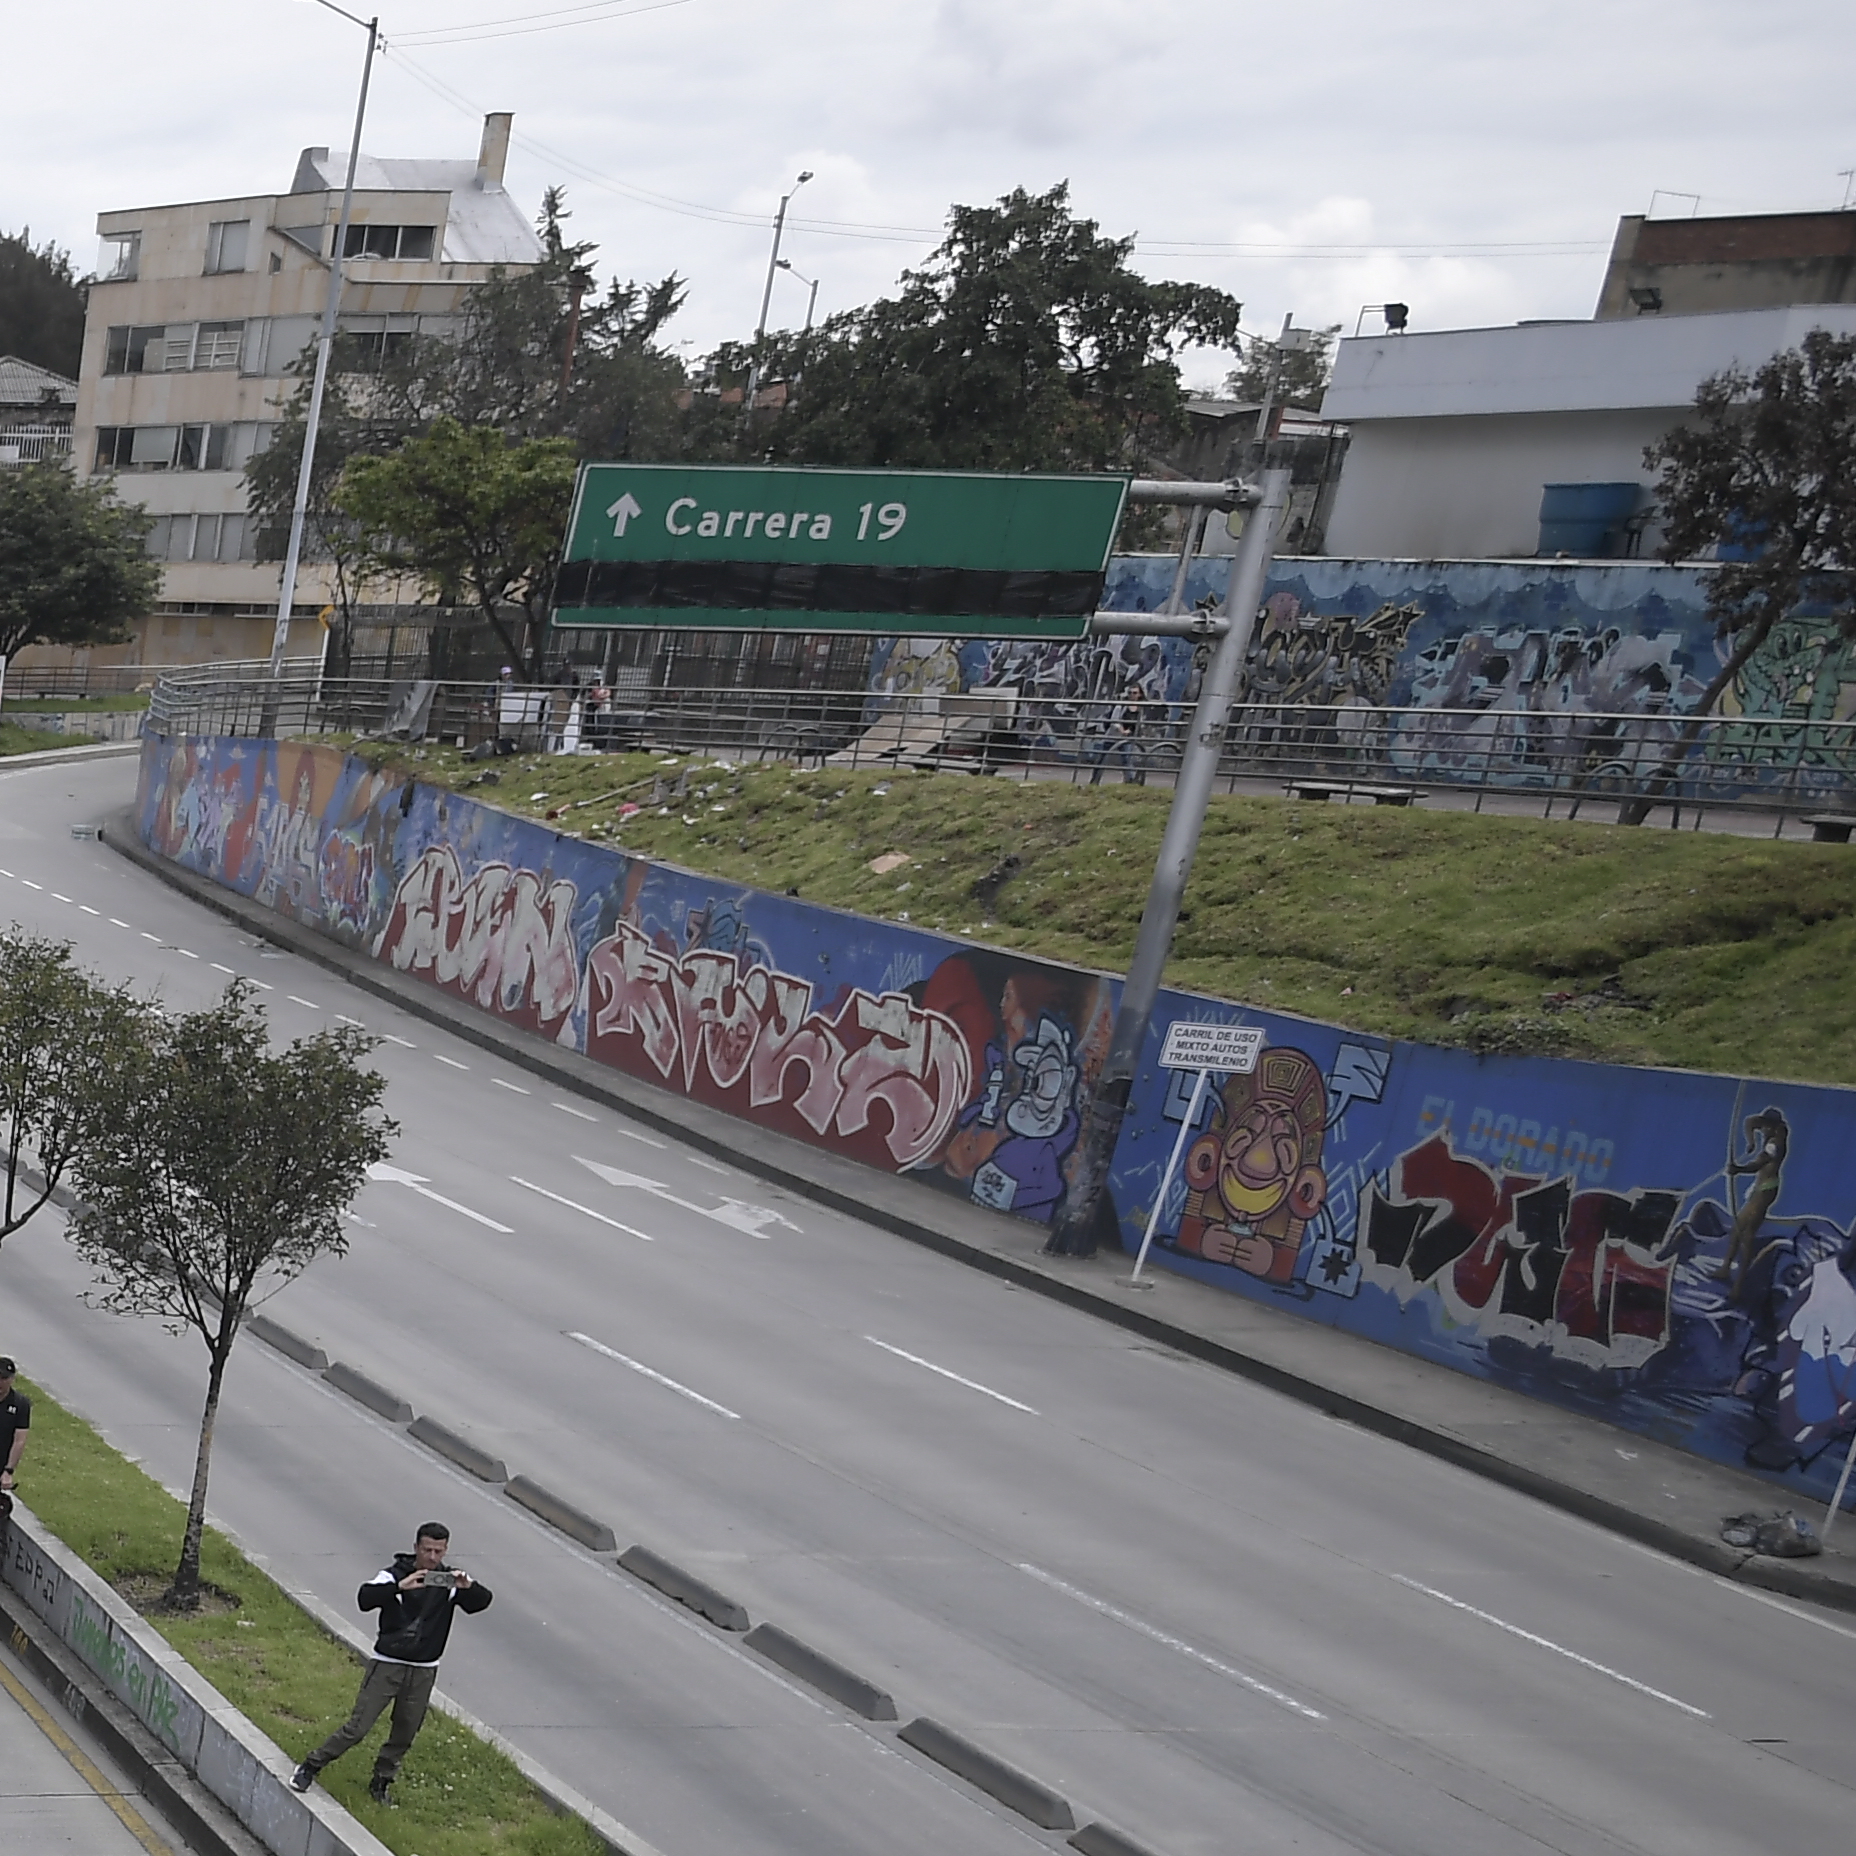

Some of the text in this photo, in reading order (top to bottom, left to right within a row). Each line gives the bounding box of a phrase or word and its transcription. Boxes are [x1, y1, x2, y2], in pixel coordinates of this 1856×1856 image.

[665, 498, 907, 542] Carrera 19
[1174, 1028, 1257, 1043] CARRIL DE USO
[1176, 1040, 1248, 1054] MIXTO AUTOS
[1168, 1052, 1248, 1067] TRANSMILENIO
[1465, 1106, 1614, 1183] DORADO
